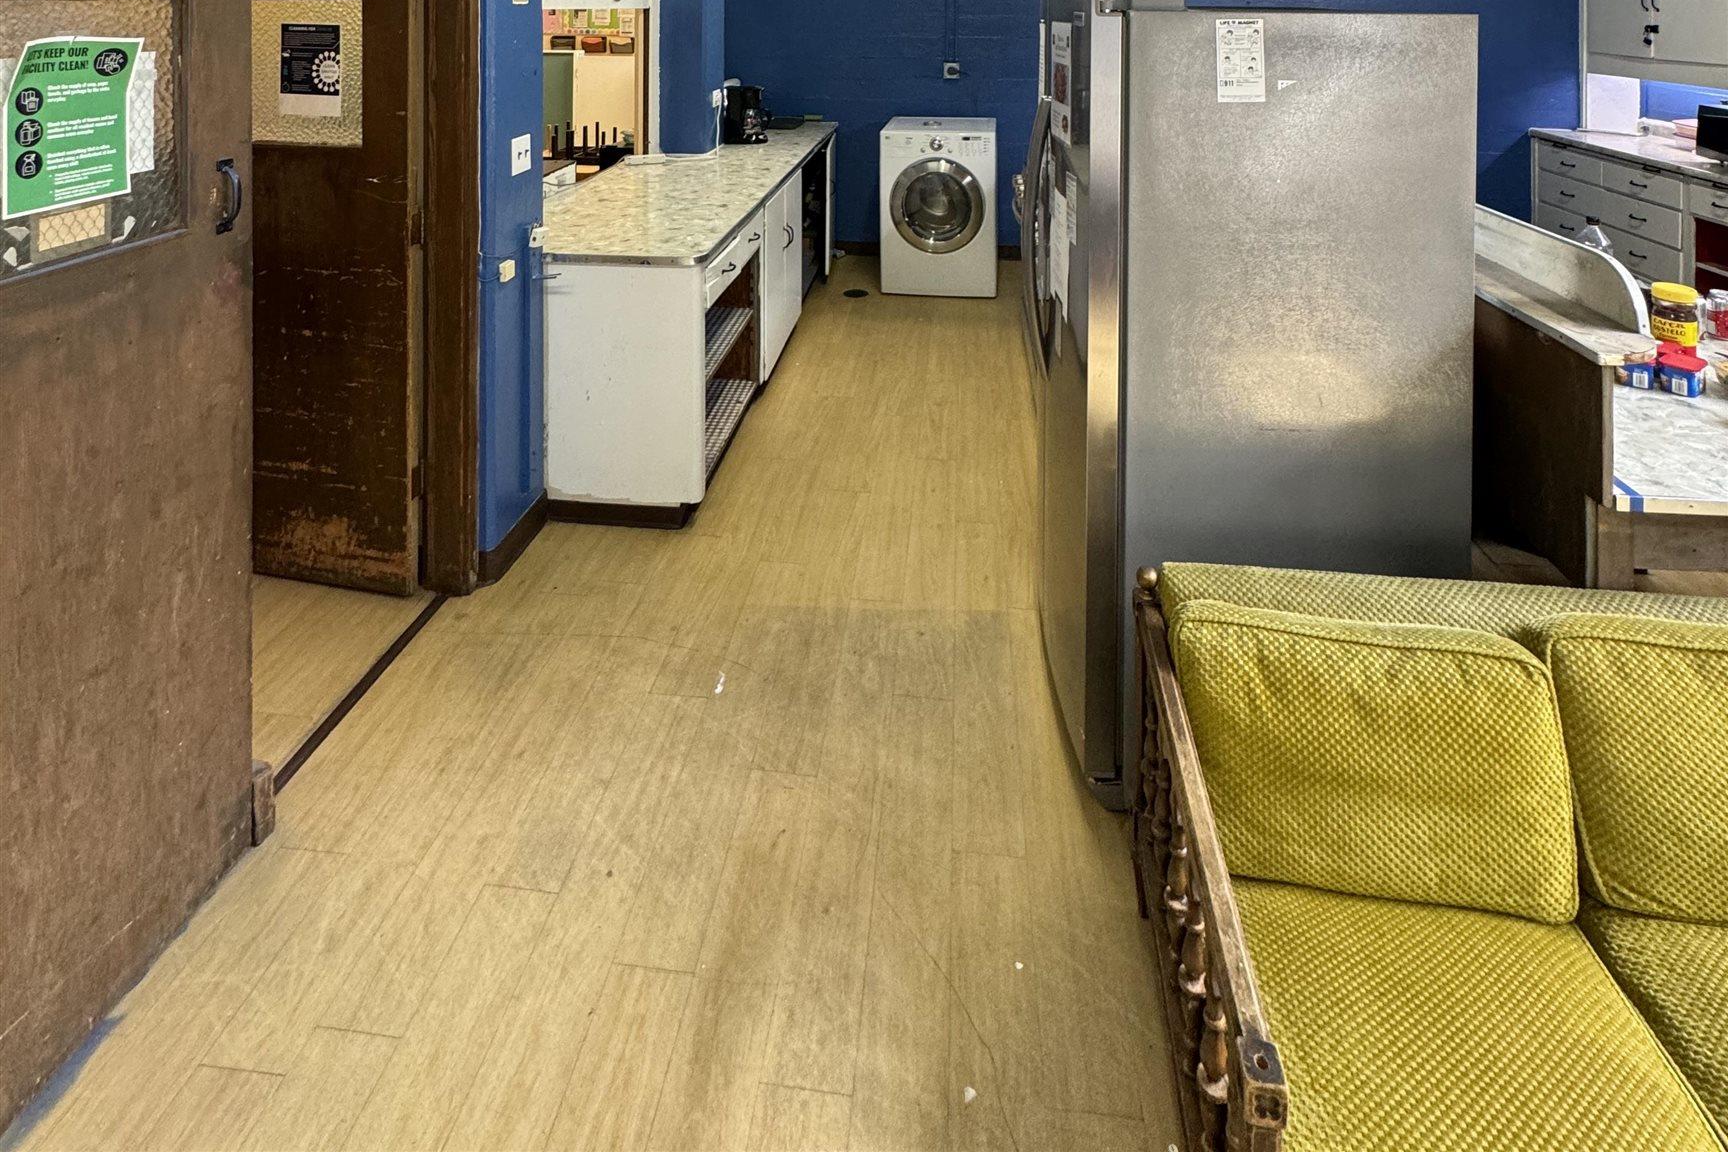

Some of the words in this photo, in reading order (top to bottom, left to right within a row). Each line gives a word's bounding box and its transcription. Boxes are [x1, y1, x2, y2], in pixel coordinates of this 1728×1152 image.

[43, 48, 65, 59] KEEP
[68, 47, 89, 57] OUR
[58, 60, 89, 72] CLEAN!
